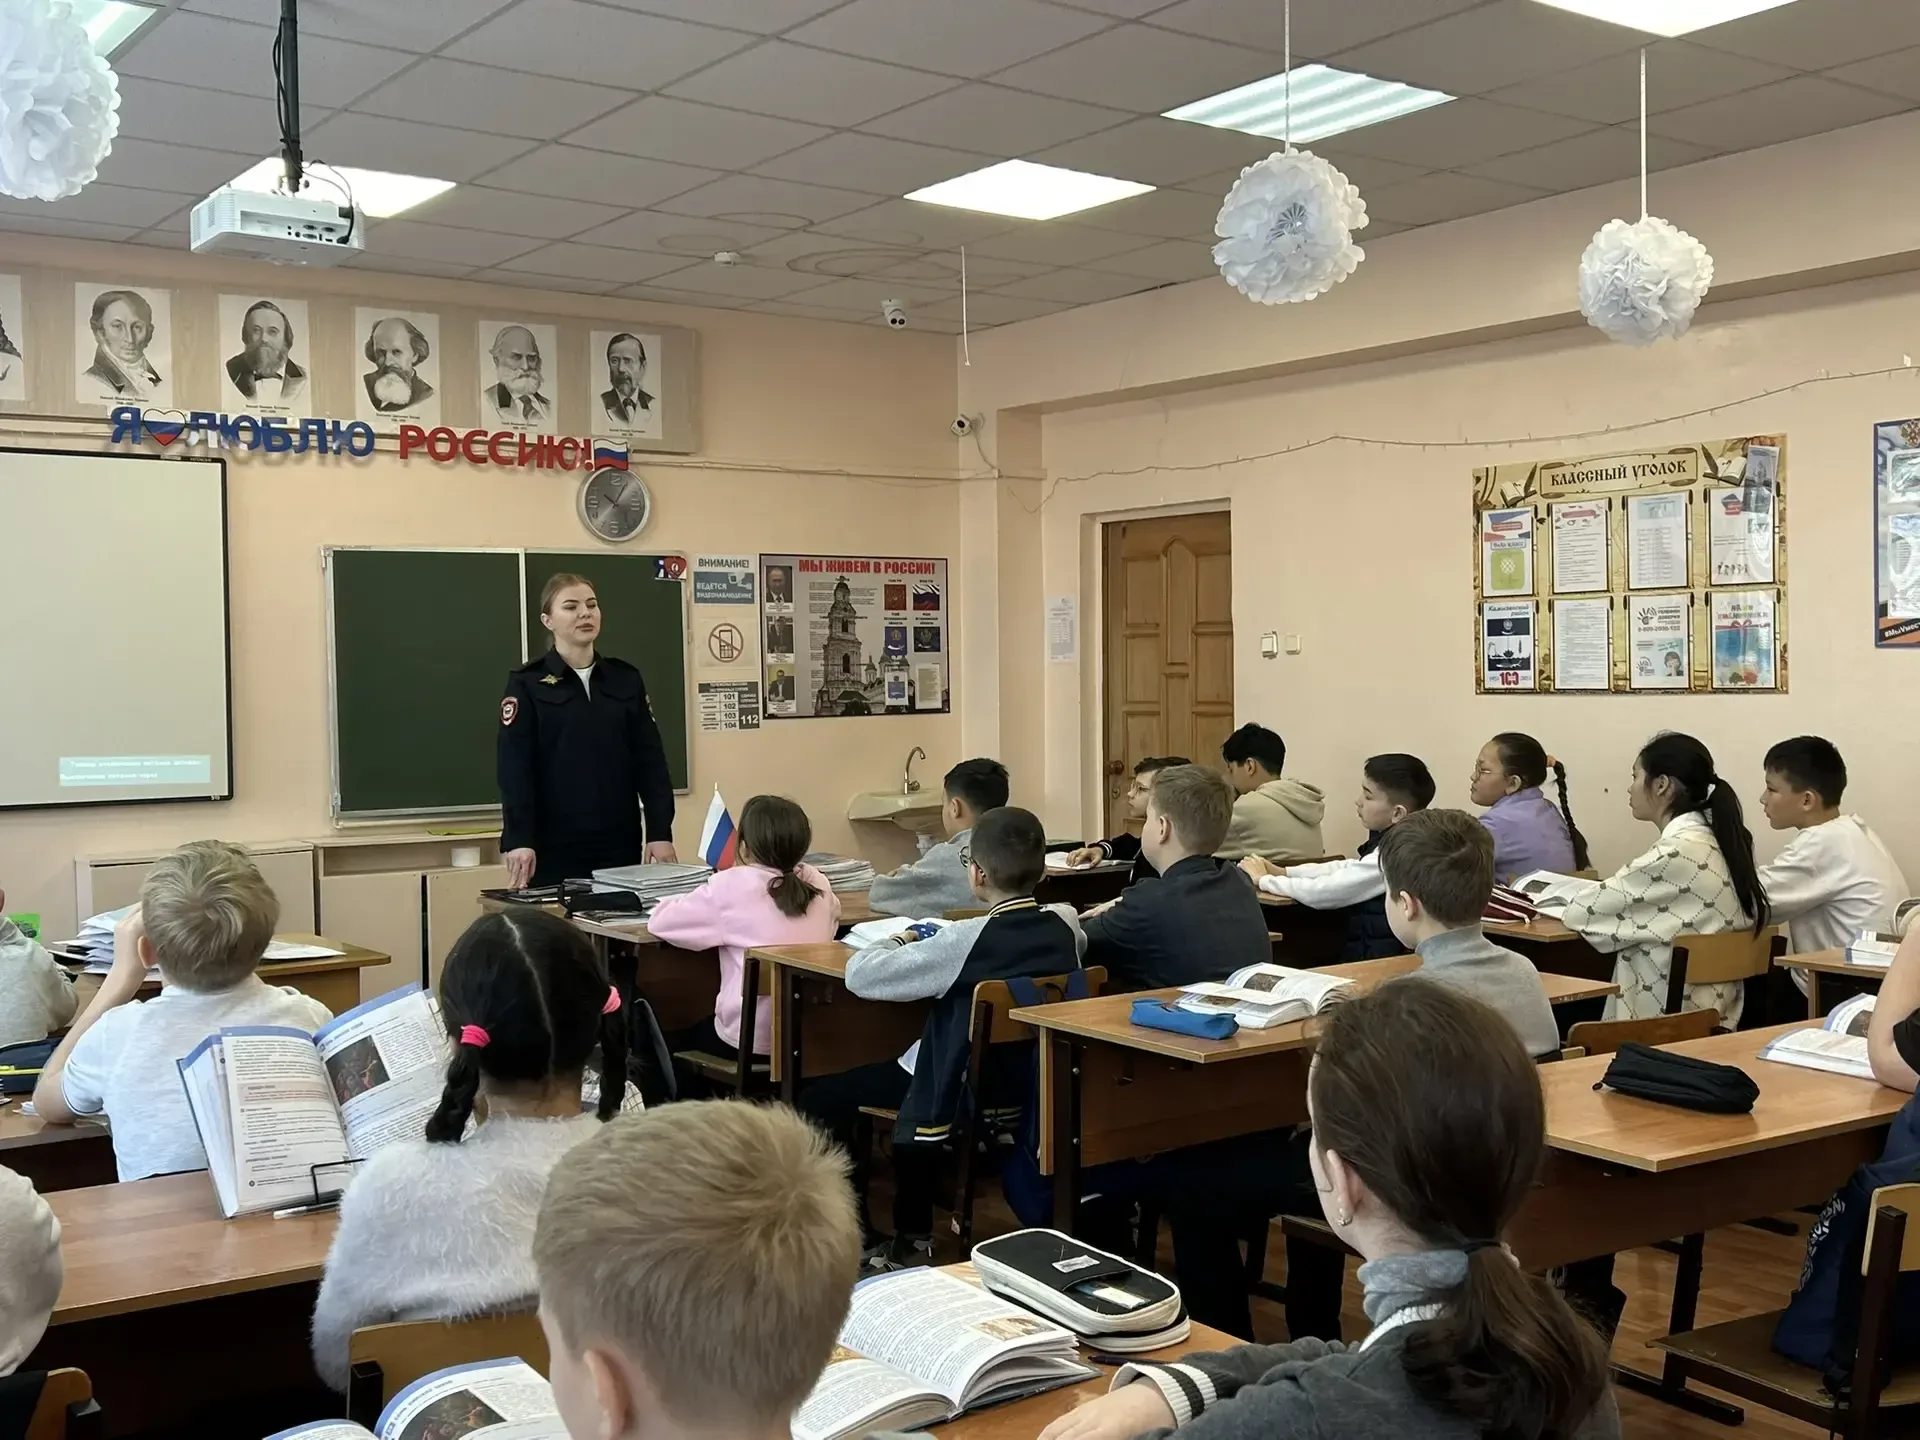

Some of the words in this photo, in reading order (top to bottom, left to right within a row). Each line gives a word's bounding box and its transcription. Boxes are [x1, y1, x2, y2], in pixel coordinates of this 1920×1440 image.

[110, 406, 141, 445] Я
[187, 411, 376, 457] ЛЮБЛЮ
[399, 424, 594, 471] РОССИЮ!
[1550, 464, 1628, 486] КЛАССНЫЙ
[1631, 459, 1687, 481] УГОЛОК
[698, 558, 750, 568] ВНИМАНИЕ!
[798, 560, 823, 573] МЫ
[825, 560, 871, 574] ЖИВЕМ
[873, 561, 881, 574] В
[884, 562, 936, 575] РОССИИ!
[696, 582, 728, 590] ВЕДЕТСЯ
[1499, 671, 1520, 686] 100
[740, 715, 759, 725] 112
